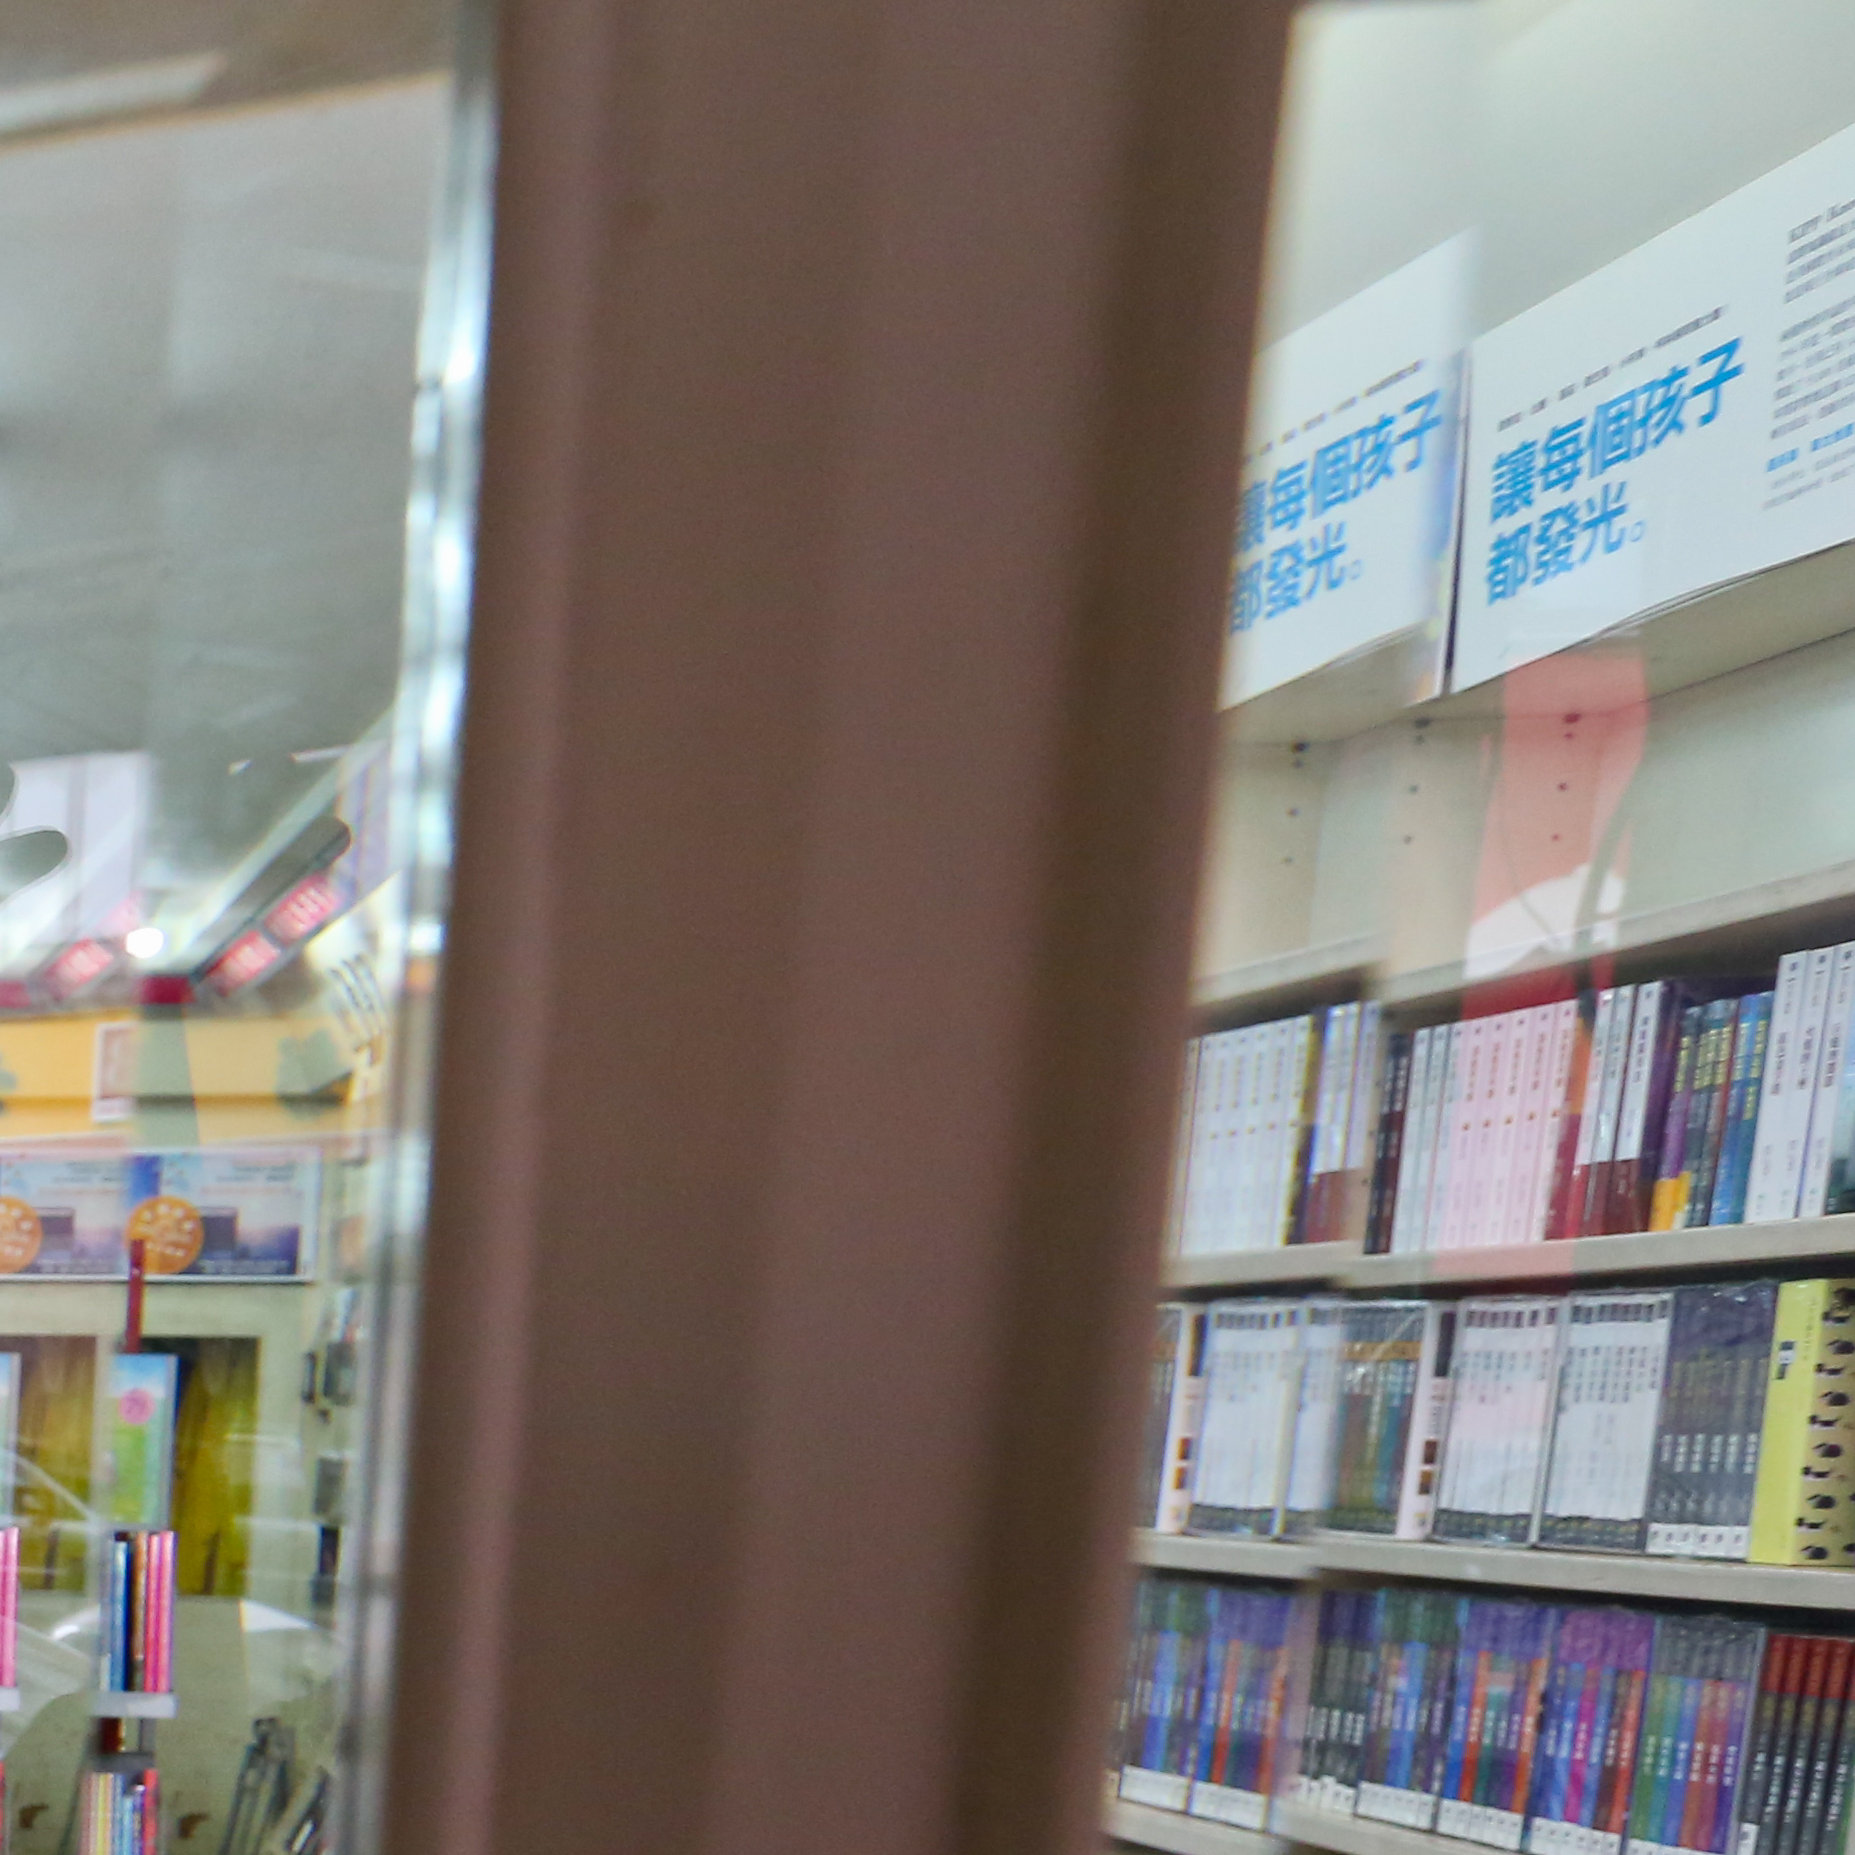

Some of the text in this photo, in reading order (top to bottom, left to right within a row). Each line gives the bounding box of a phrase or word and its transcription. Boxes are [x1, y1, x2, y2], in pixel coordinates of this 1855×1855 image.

[1489, 336, 1745, 526] 讓每個孩子
